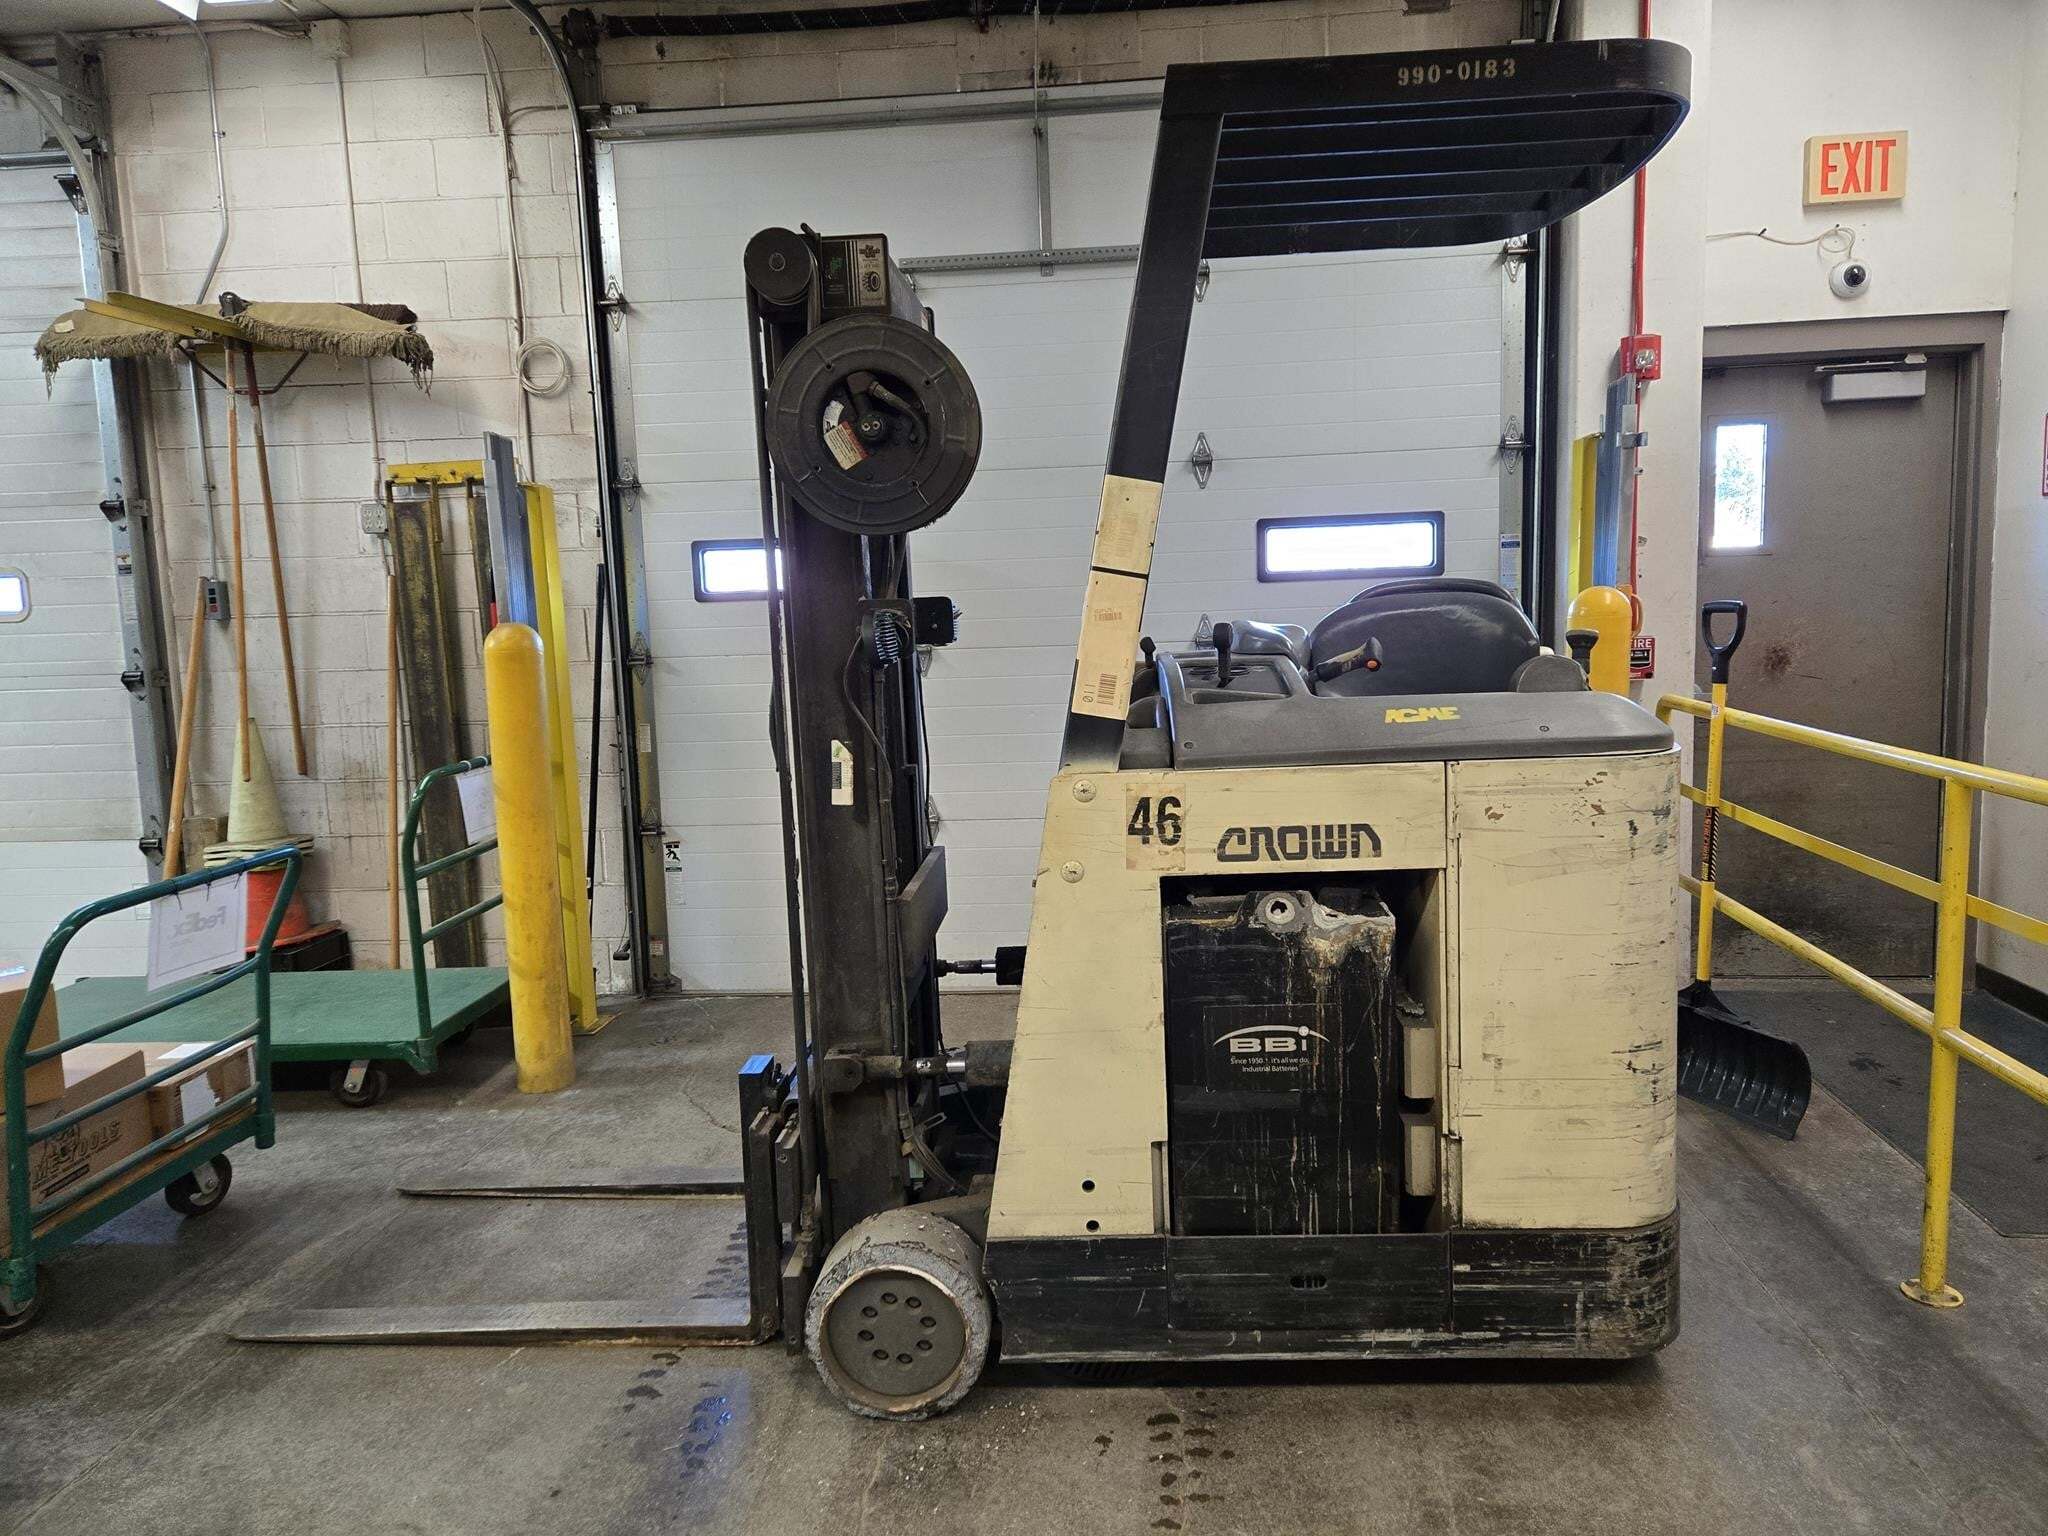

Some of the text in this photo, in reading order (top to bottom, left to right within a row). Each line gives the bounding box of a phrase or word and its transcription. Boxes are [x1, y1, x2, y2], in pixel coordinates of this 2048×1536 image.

[1398, 58, 1516, 87] 990-0183
[1820, 139, 1897, 195] EXIT
[1127, 796, 1182, 847] 46
[1216, 823, 1382, 863] CROWN
[1242, 1065, 1271, 1073] Industrial
